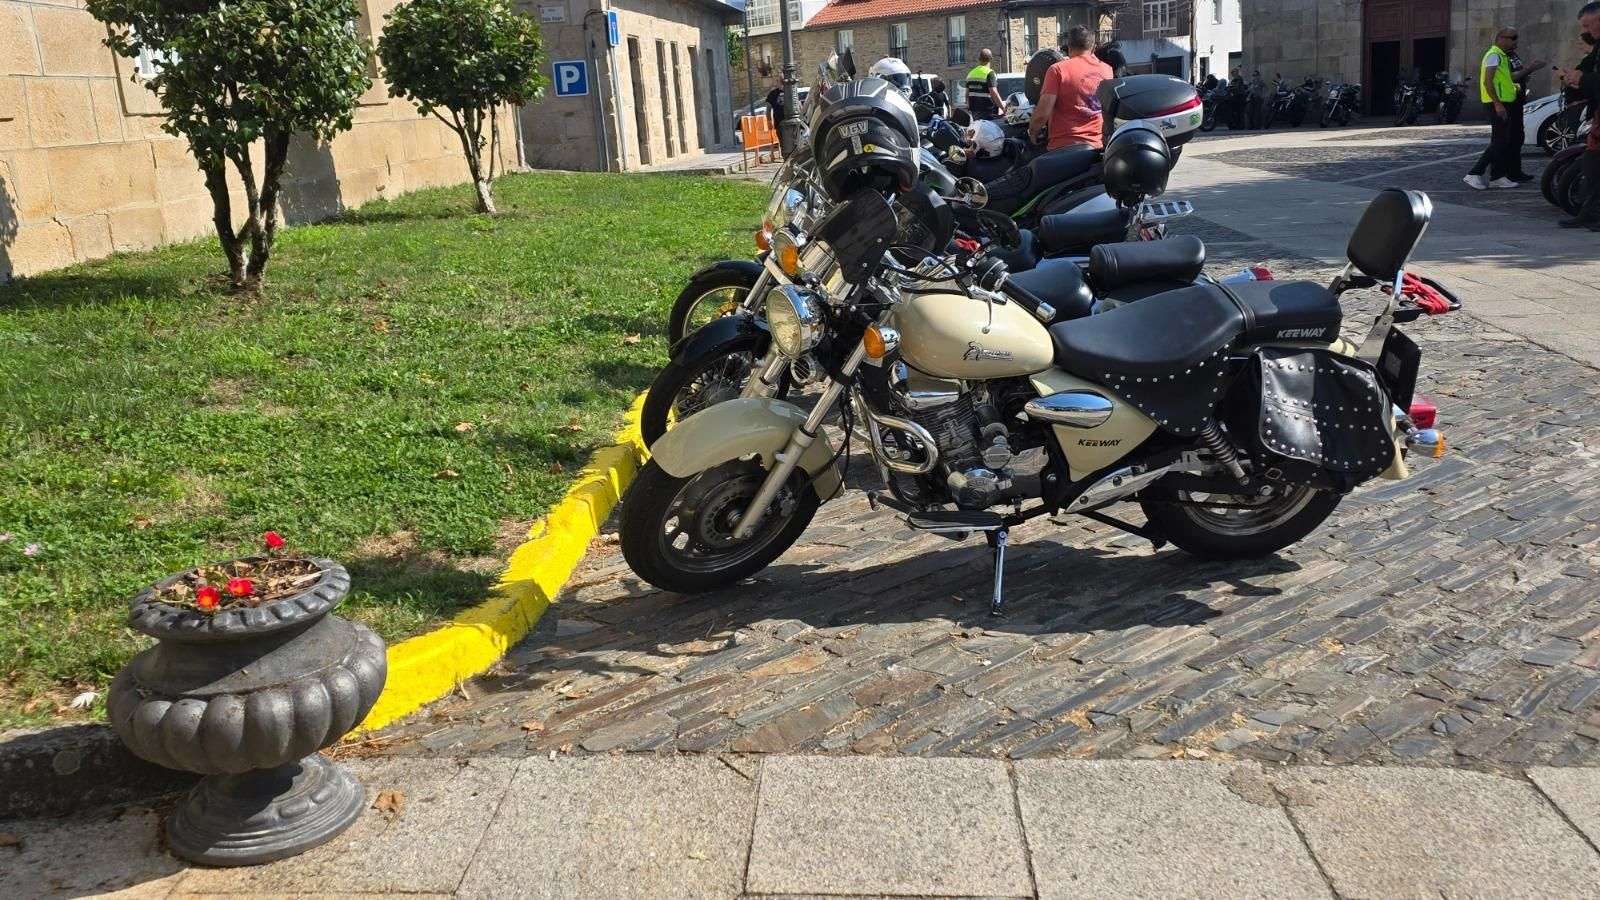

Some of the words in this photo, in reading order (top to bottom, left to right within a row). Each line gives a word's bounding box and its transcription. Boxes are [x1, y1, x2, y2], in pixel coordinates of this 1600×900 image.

[559, 65, 580, 92] P
[838, 120, 868, 139] VGV
[1277, 327, 1326, 338] KEEWAY
[1078, 438, 1122, 447] KEEWAY
